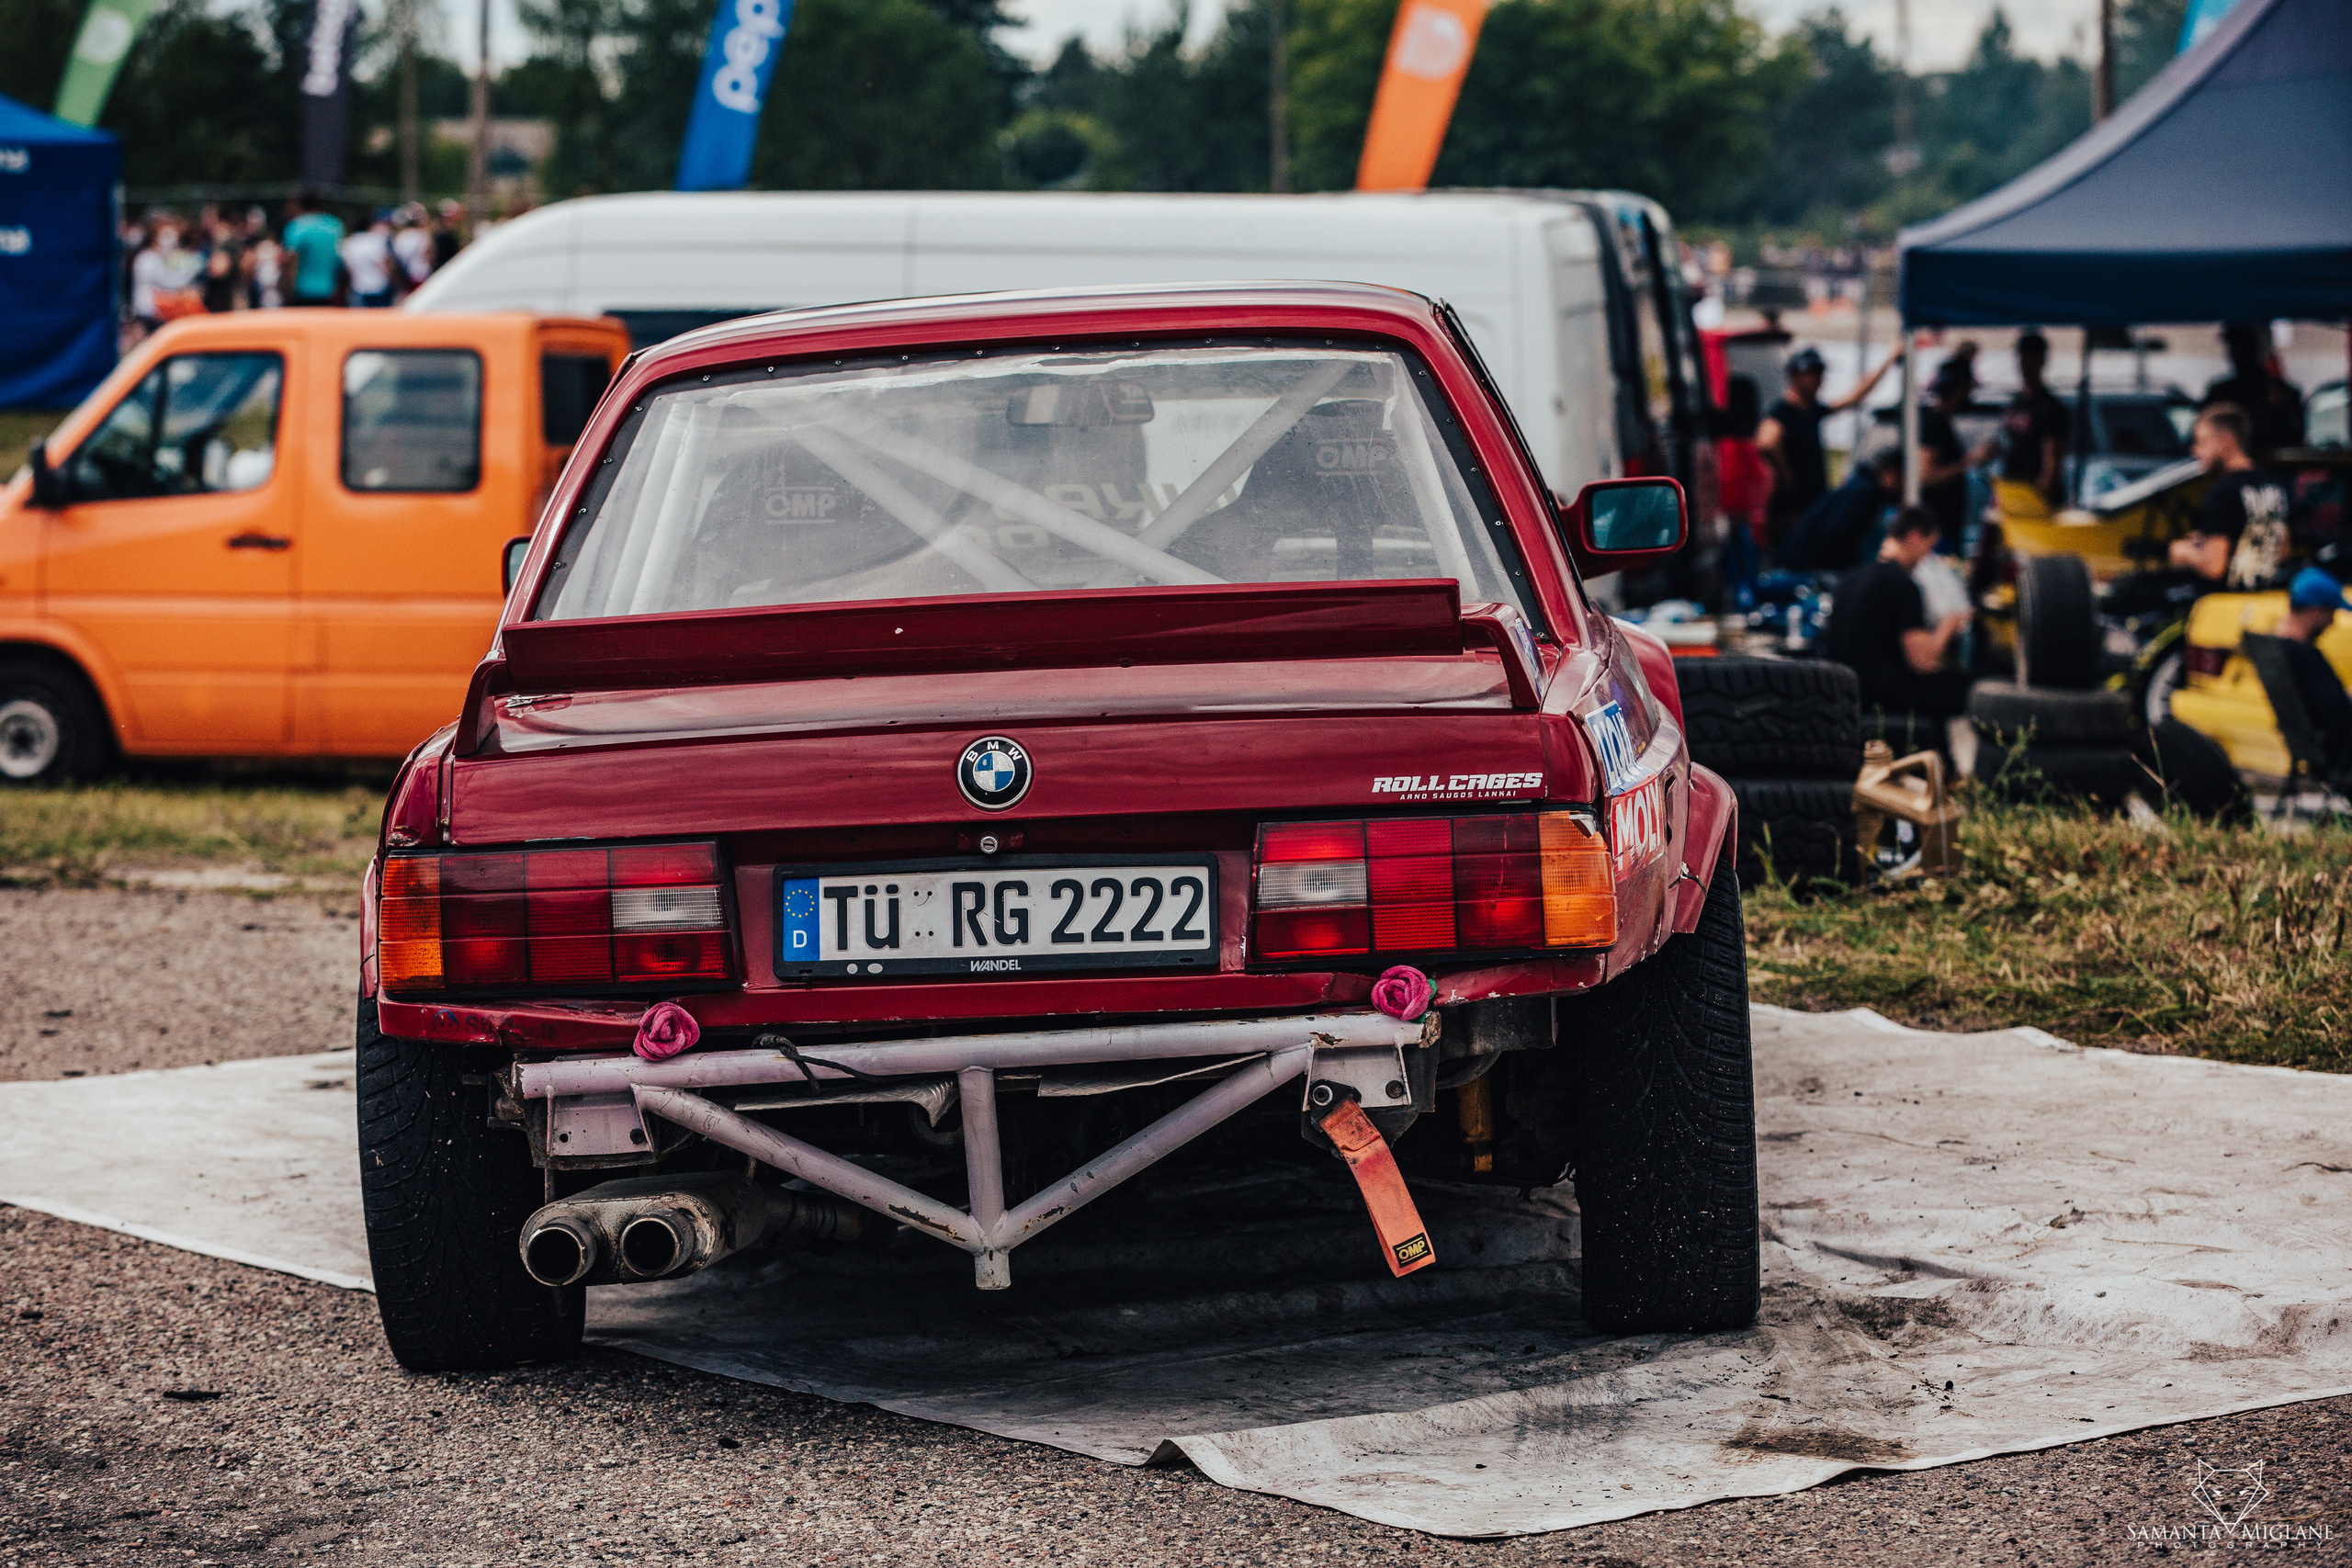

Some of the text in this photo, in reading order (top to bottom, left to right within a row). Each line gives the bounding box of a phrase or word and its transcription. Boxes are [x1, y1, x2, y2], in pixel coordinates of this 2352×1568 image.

[1317, 444, 1388, 469] OMP
[764, 493, 836, 517] OMP
[966, 740, 1023, 762] BMW
[1372, 773, 1544, 793] ROLL CAGES
[1478, 790, 1517, 798] LANKAI
[1615, 779, 1661, 872] MOLY
[823, 875, 1205, 952] Tü RG 2222
[793, 930, 808, 949] D
[970, 959, 1022, 972] WANDEL
[1398, 1240, 1426, 1259] OMP
